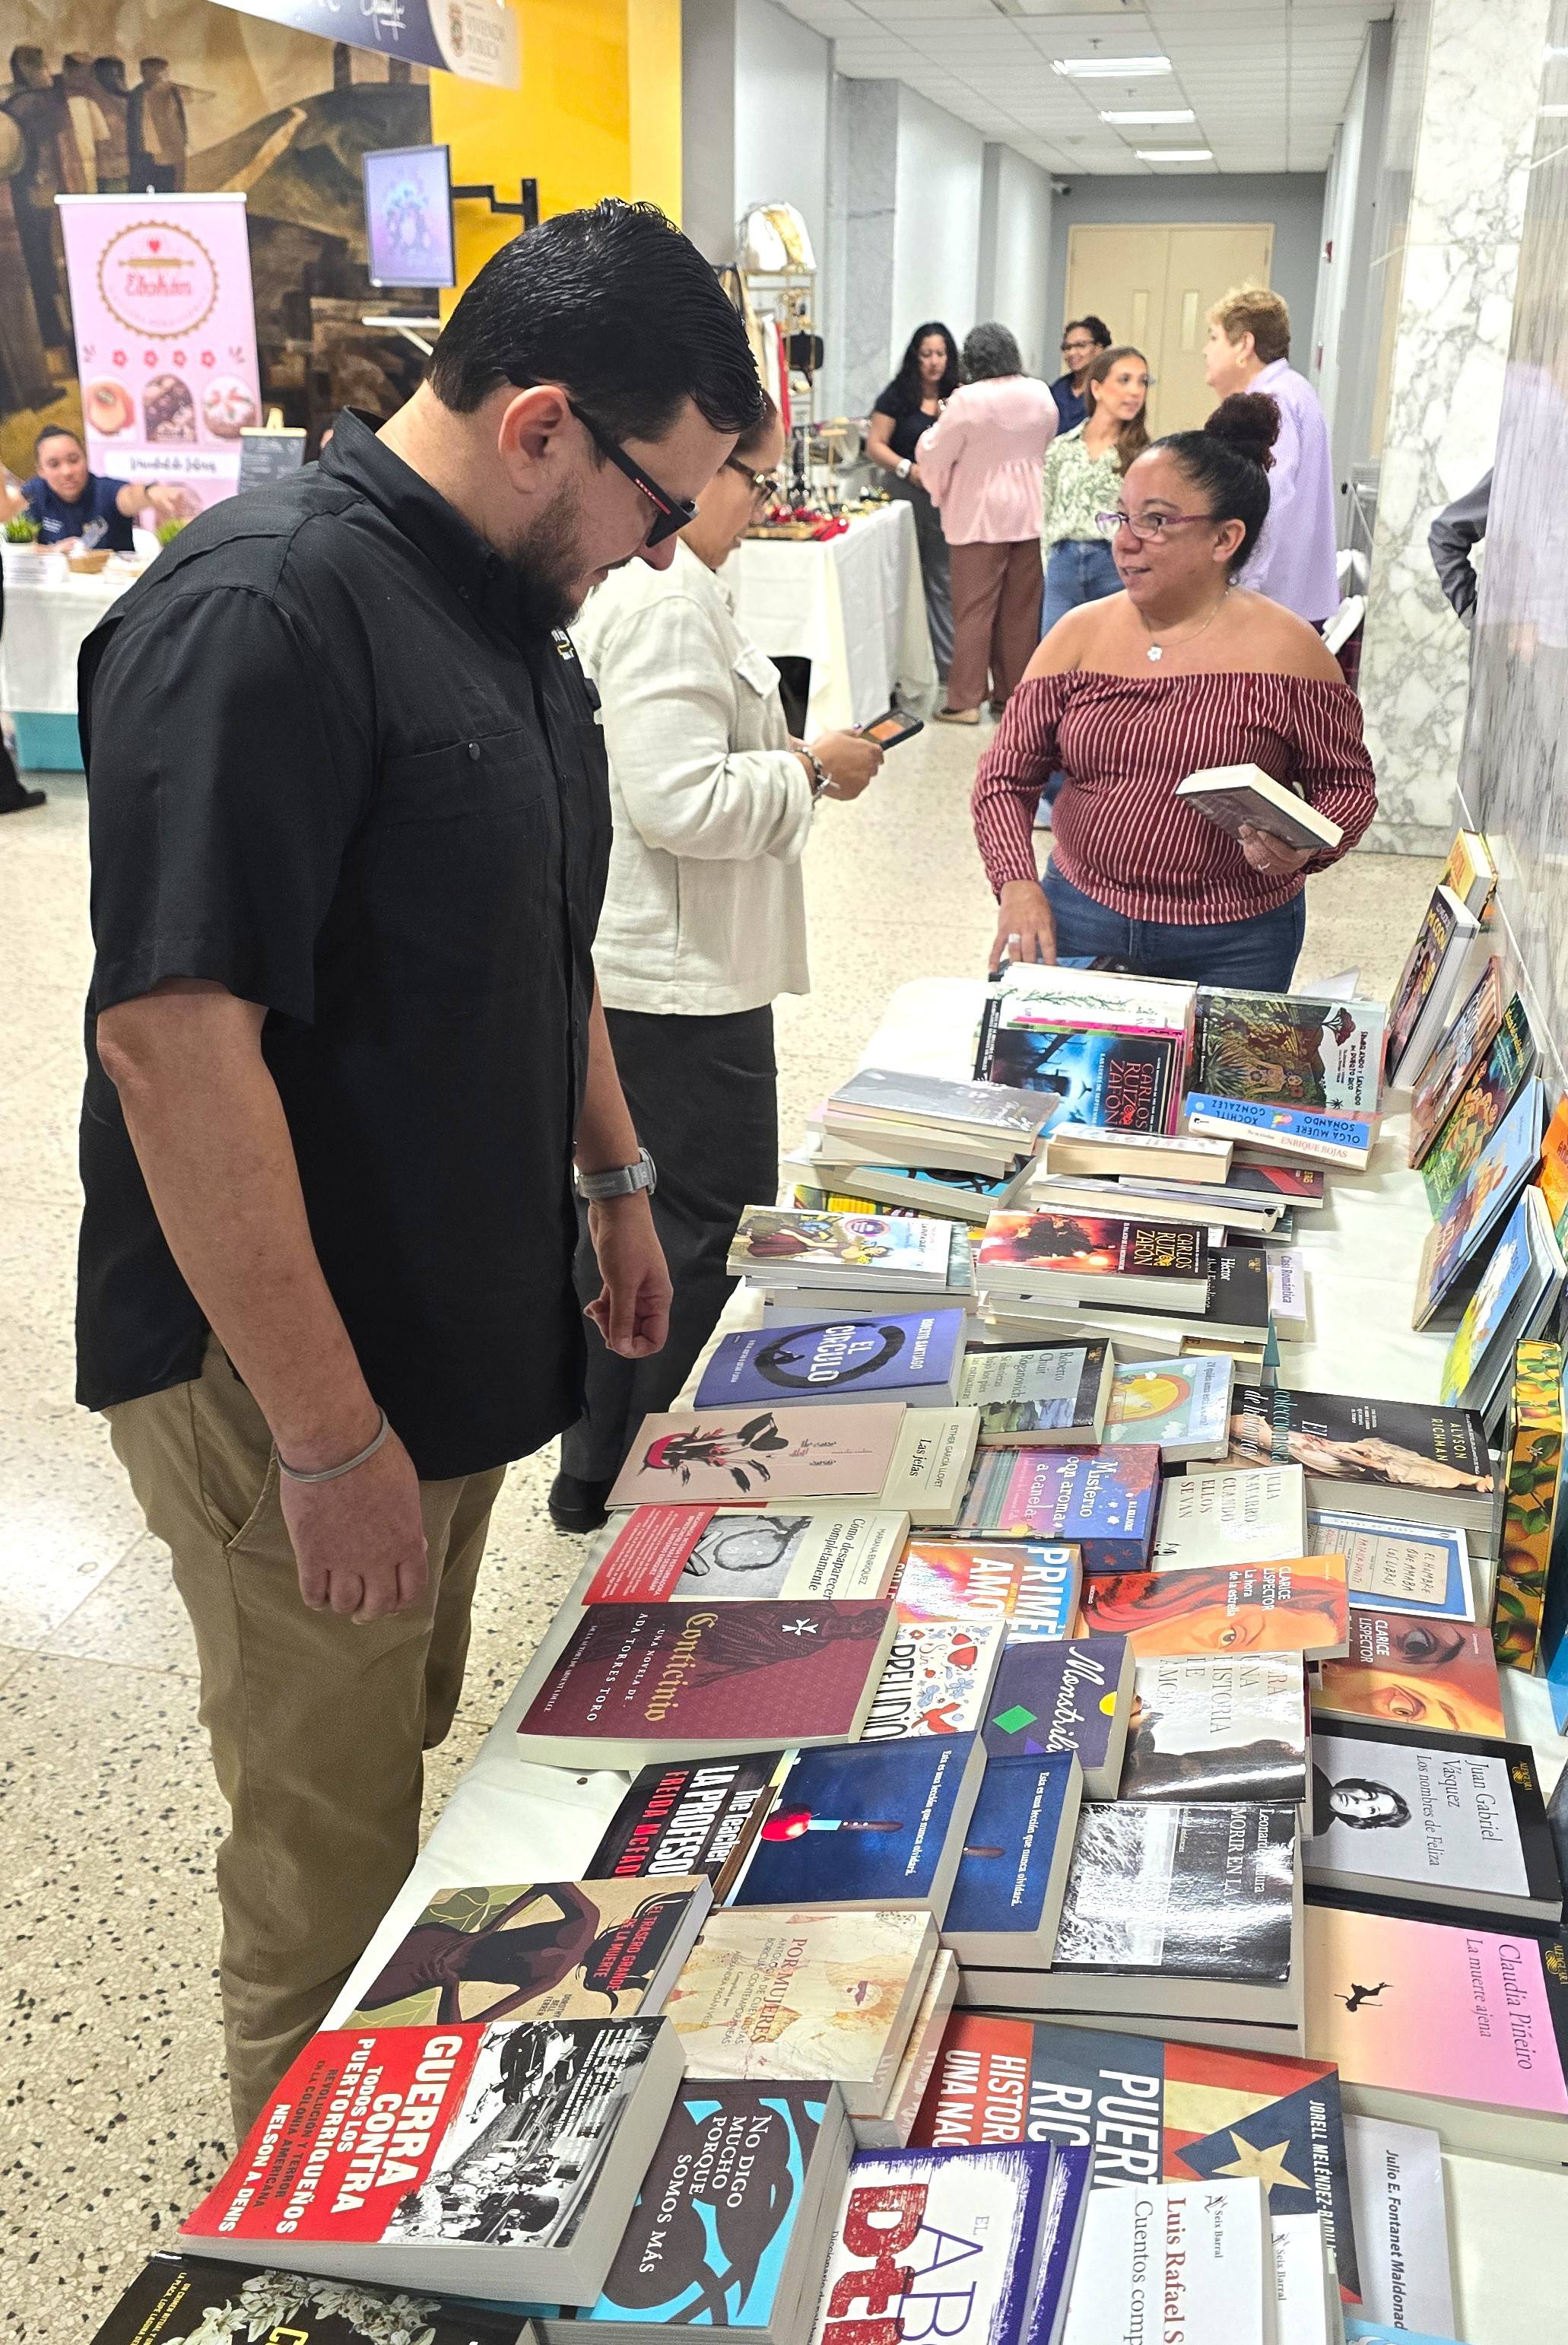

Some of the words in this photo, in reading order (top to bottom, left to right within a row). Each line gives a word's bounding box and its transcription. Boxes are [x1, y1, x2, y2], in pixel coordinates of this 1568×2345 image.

[1104, 1060, 1124, 1126] ZAFÓN
[1124, 1061, 1141, 1107] RUIZ
[1135, 1063, 1154, 1129] CARLOS
[1296, 1125, 1329, 1137] MUERE
[1304, 1116, 1356, 1132] SOÑANDO
[1332, 1131, 1360, 1143] OLGA
[1281, 1136, 1321, 1152] ENRIQUE
[1321, 1146, 1347, 1158] ROJAS
[1134, 1229, 1154, 1266] ZAFÓN
[1156, 1231, 1176, 1258] RUIZ
[1176, 1233, 1193, 1269] CARLOS
[1220, 1257, 1236, 1281] Héctor
[1281, 1256, 1293, 1269] Casi
[1281, 1270, 1293, 1304] Romántica
[807, 1326, 856, 1382] CÍRCULO
[846, 1341, 875, 1355] EL
[1036, 1353, 1053, 1374] Chuit
[1011, 1355, 1034, 1397] Roganovich
[1055, 1352, 1074, 1381] Roberto
[1244, 1390, 1269, 1404] de
[916, 1438, 932, 1456] Las
[946, 1425, 959, 1445] ESTHER
[1430, 1418, 1449, 1462] RICHMAN
[1449, 1422, 1468, 1460] ALYSON
[909, 1455, 925, 1476] jefas
[1063, 1456, 1079, 1478] con
[1025, 1474, 1055, 1518] canela
[1052, 1481, 1074, 1521] aroma
[1079, 1460, 1119, 1517] Misterio
[1181, 1481, 1195, 1495] SE
[1200, 1479, 1216, 1513] ELLOS
[1220, 1477, 1236, 1522] CUANDO
[1244, 1474, 1260, 1523] NAVARRO
[1264, 1473, 1281, 1500] JULIA
[1179, 1497, 1194, 1518] VAN
[845, 1517, 865, 1541] Cómo
[870, 1528, 887, 1555] MARIANA
[808, 1524, 843, 1591] completamente
[823, 1541, 855, 1599] desaparecer
[858, 1555, 877, 1585] ENRIQUEZ
[1229, 1571, 1243, 1581] de
[1244, 1580, 1258, 1597] hora
[1245, 1569, 1258, 1579] La
[1262, 1568, 1276, 1612] LISPECTOR
[1278, 1566, 1291, 1600] CLARICE
[1227, 1590, 1240, 1617] estrella
[631, 1613, 648, 1634] ADA
[651, 1629, 665, 1647] UNA
[1376, 1619, 1390, 1656] CLARICE
[1359, 1617, 1374, 1663] LISPECTOR
[606, 1638, 636, 1682] TORRES
[633, 1650, 655, 1686] NOVELA
[644, 1613, 718, 1721] Conticinio
[587, 1687, 611, 1721] TORO
[625, 1689, 636, 1700] DE
[939, 1750, 951, 1763] Esta
[1417, 1754, 1432, 1772] Los
[689, 1765, 740, 1787] LA
[933, 1771, 943, 1784] una
[1037, 1772, 1049, 1786] Esta
[1438, 1759, 1461, 1808] Vásquez
[1465, 1759, 1489, 1789] Juan
[642, 1770, 690, 1818] FREIDA
[1033, 1794, 1042, 1809] una
[1419, 1775, 1439, 1818] nombres
[921, 1808, 932, 1822] que
[1027, 1810, 1043, 1834] lección
[1227, 1807, 1246, 1852] MORIR
[1424, 1819, 1442, 1832] de
[1474, 1794, 1503, 1841] Gabriel
[915, 1822, 927, 1845] nunca
[1023, 1834, 1033, 1849] que
[1018, 1849, 1030, 1872] nunca
[1226, 1857, 1243, 1874] EN
[1426, 1835, 1443, 1867] Feliza
[1224, 1878, 1241, 1896] LA
[650, 1905, 663, 1916] EL
[615, 1931, 631, 1944] LA
[627, 1917, 658, 1953] TRASERO
[1465, 1937, 1484, 1953] La
[593, 1944, 625, 1978] MUERTE
[780, 1938, 808, 1968] POR
[607, 1956, 634, 1991] GRANDE
[757, 1984, 768, 1994] DE
[1469, 1956, 1486, 2006] muerte
[1498, 1943, 1528, 2007] Claudia
[750, 1972, 793, 2043] MUJERES
[1472, 2007, 1491, 2038] ajena
[1509, 2010, 1538, 2070] Piñeiro
[306, 2072, 321, 2083] LA
[316, 2060, 325, 2071] EN
[941, 2050, 982, 2096] UNA
[304, 2068, 339, 2138] REVOLUCIÓN
[351, 2066, 383, 2117] TODOS
[287, 2085, 315, 2136] COLONIA
[375, 2035, 463, 2188] GUERRA
[1309, 2099, 1327, 2140] JORELL
[251, 2104, 291, 2168] NELSON
[276, 2038, 376, 2234] PUERTORRIQUEÑOS
[337, 2121, 359, 2153] LOS
[744, 2115, 773, 2148] NO
[330, 2093, 403, 2213] CONTRA
[688, 2115, 728, 2195] PORQUE
[712, 2116, 747, 2189] MUCHO
[1385, 2150, 1399, 2180] Julio
[245, 2171, 262, 2182] A.
[253, 2139, 292, 2208] AMERICANA
[275, 2152, 304, 2198] TERROR
[657, 2154, 692, 2223] SOMOS
[727, 2155, 754, 2207] DIGO
[1387, 2181, 1401, 2194] E.
[218, 2187, 256, 2232] DENIS
[973, 2215, 989, 2235] EL
[1166, 2197, 1187, 2245] Luis
[1214, 2210, 1223, 2232] Seix
[1131, 2200, 1154, 2283] Cuentos
[1389, 2196, 1401, 2257] Fontanet
[639, 2230, 667, 2273] MÁS
[1214, 2231, 1224, 2258] Barral
[1276, 2248, 1286, 2270] Seix
[1163, 2251, 1186, 2324] Rafael
[1277, 2271, 1287, 2302] Barral
